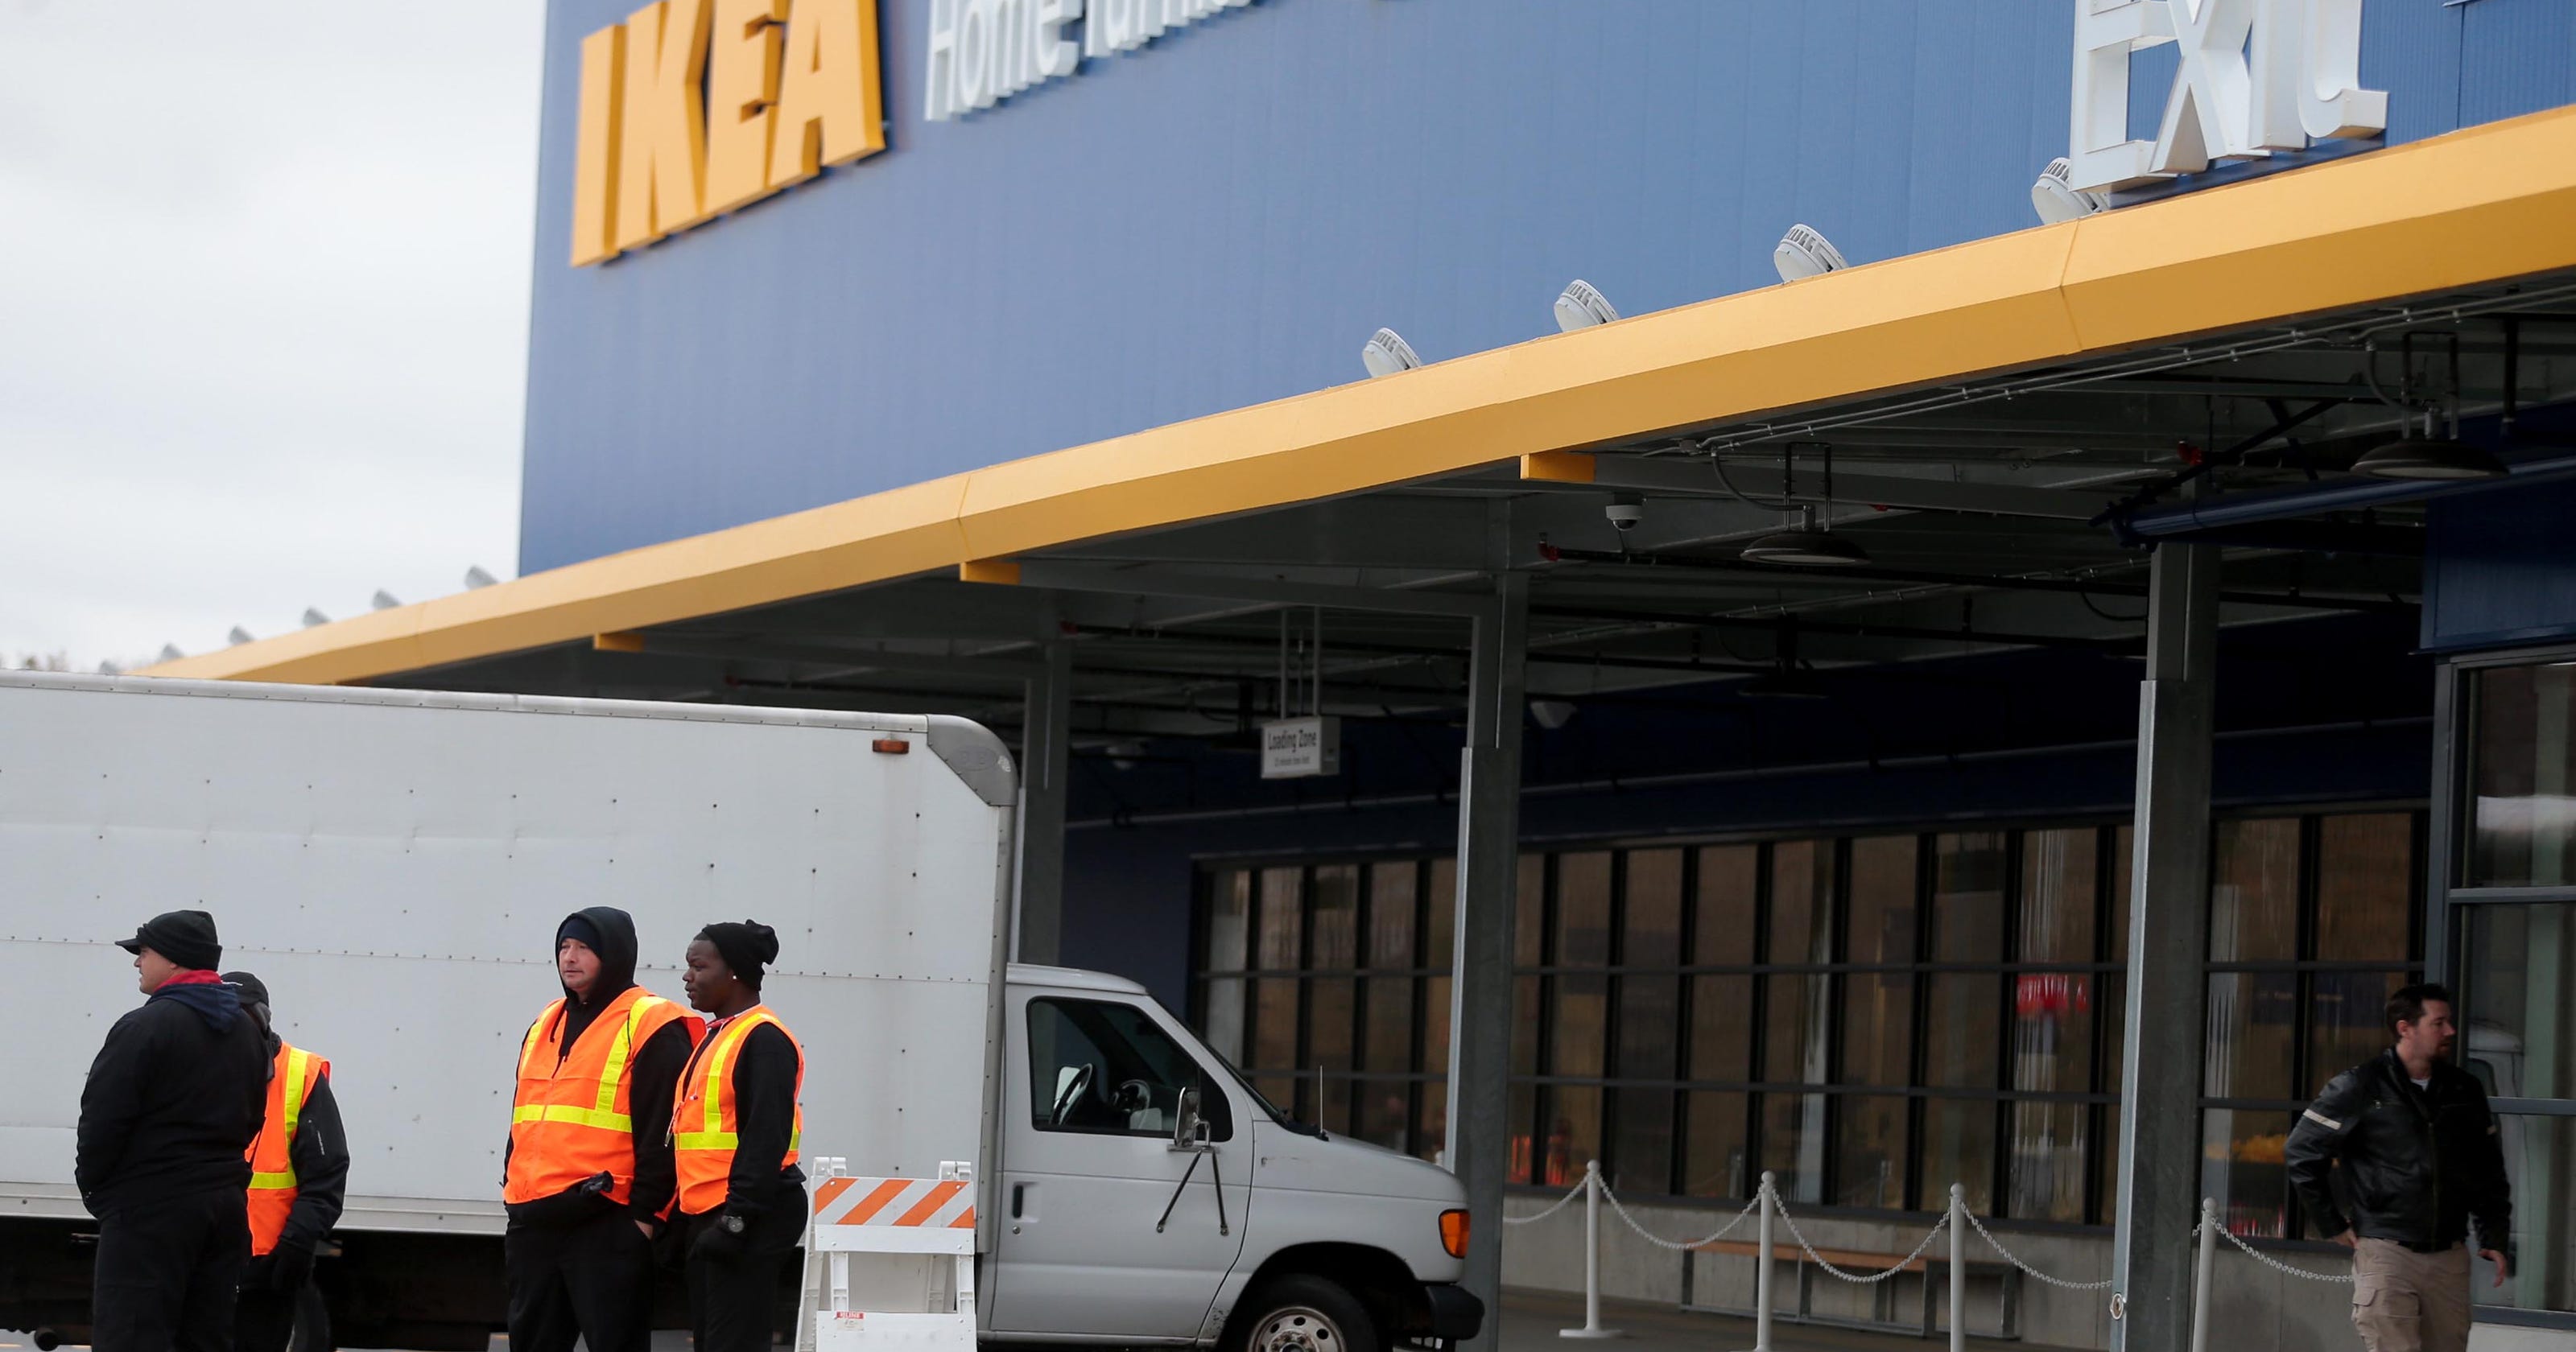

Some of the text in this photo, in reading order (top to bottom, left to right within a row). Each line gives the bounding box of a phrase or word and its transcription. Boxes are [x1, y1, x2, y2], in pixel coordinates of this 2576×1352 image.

[924, 0, 1083, 121] Home
[571, 0, 886, 268] IKEA
[1267, 728, 1317, 753] Loading Zone
